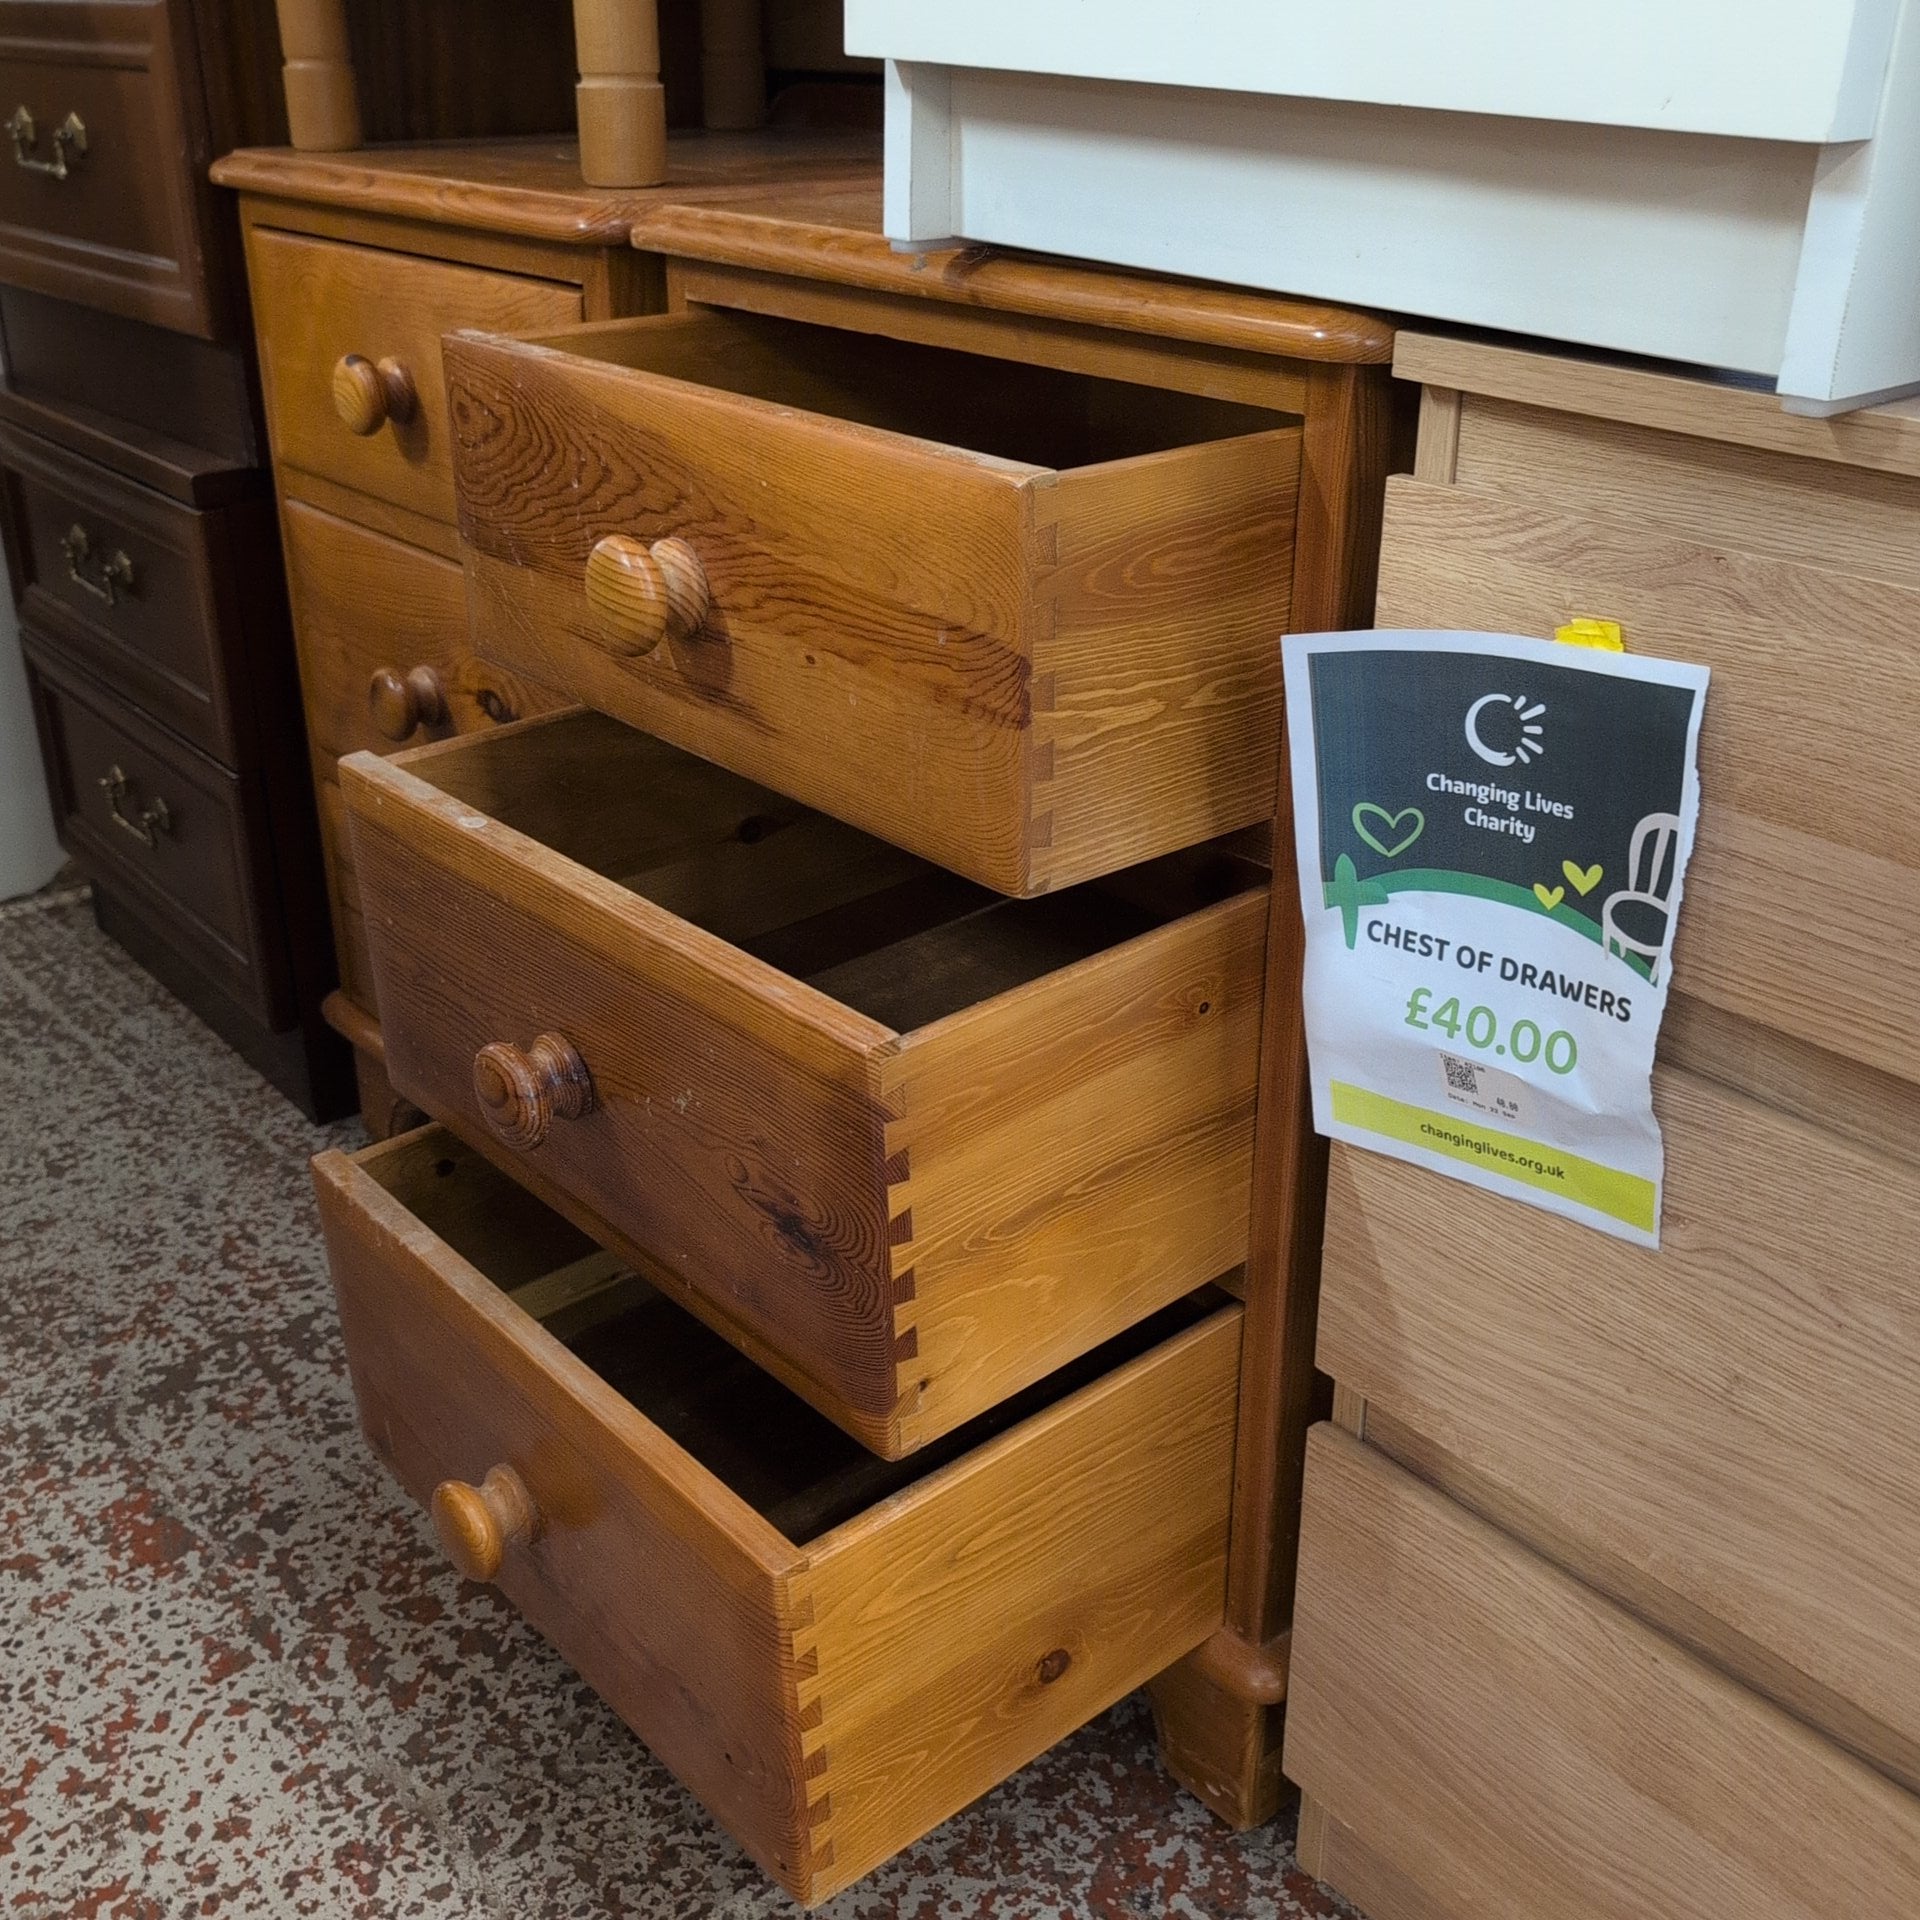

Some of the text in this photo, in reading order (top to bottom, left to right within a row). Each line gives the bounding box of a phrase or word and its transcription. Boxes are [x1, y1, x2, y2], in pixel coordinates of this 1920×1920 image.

[1426, 773, 1574, 819] Changing Lives
[1464, 807, 1535, 844] Charity
[1367, 920, 1632, 1023] CHEST OF DRAWERS
[1404, 987, 1578, 1075] £40.00
[1420, 1123, 1565, 1180] changinglives.org.uk
